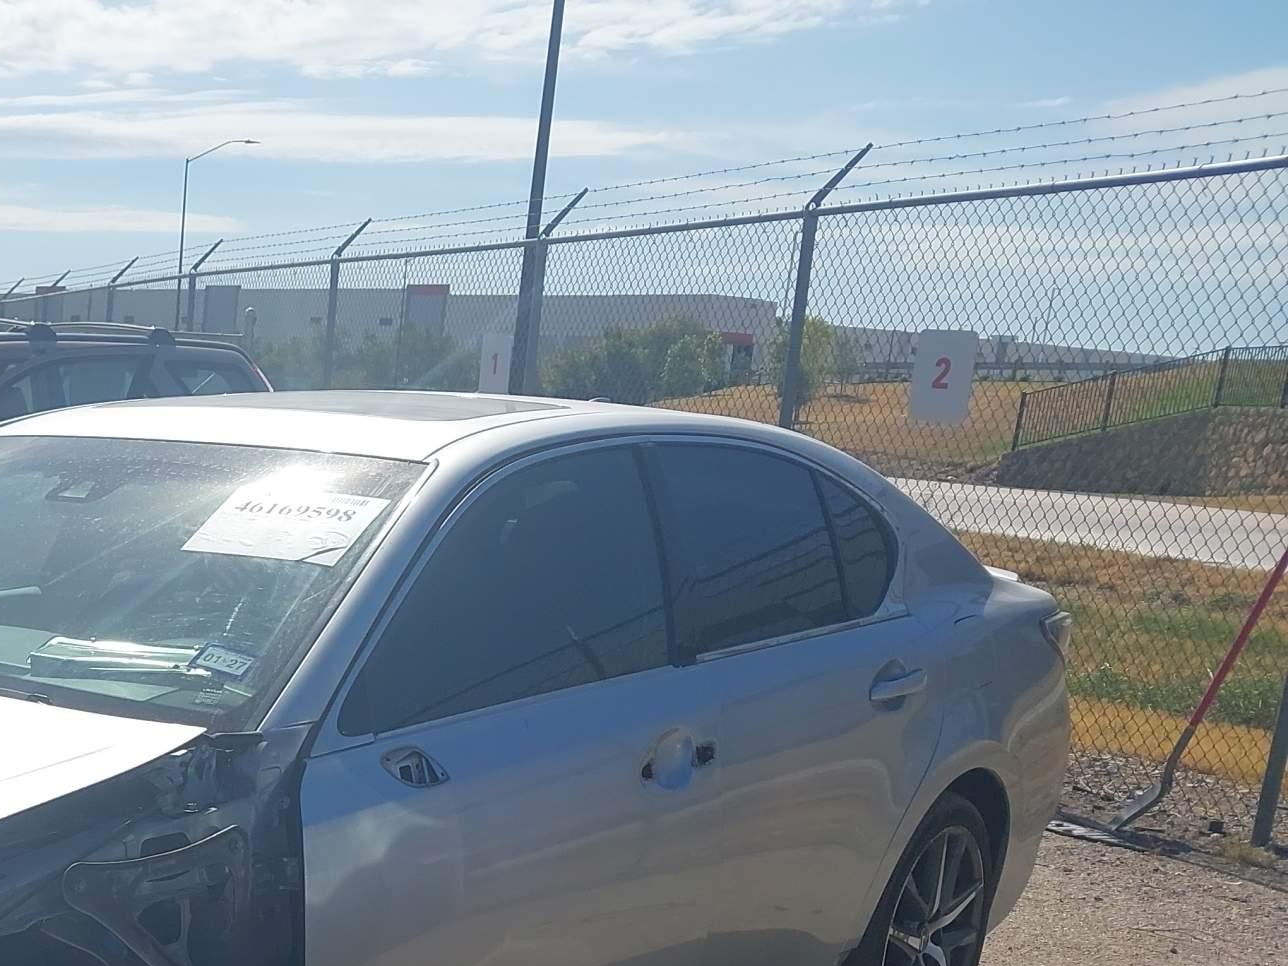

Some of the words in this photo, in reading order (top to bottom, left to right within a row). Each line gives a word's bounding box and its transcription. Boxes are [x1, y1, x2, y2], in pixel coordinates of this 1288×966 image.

[491, 352, 499, 375] 1
[931, 356, 952, 390] 2
[234, 500, 357, 523] 46169598
[203, 653, 223, 664] 01
[225, 658, 249, 671] 27
